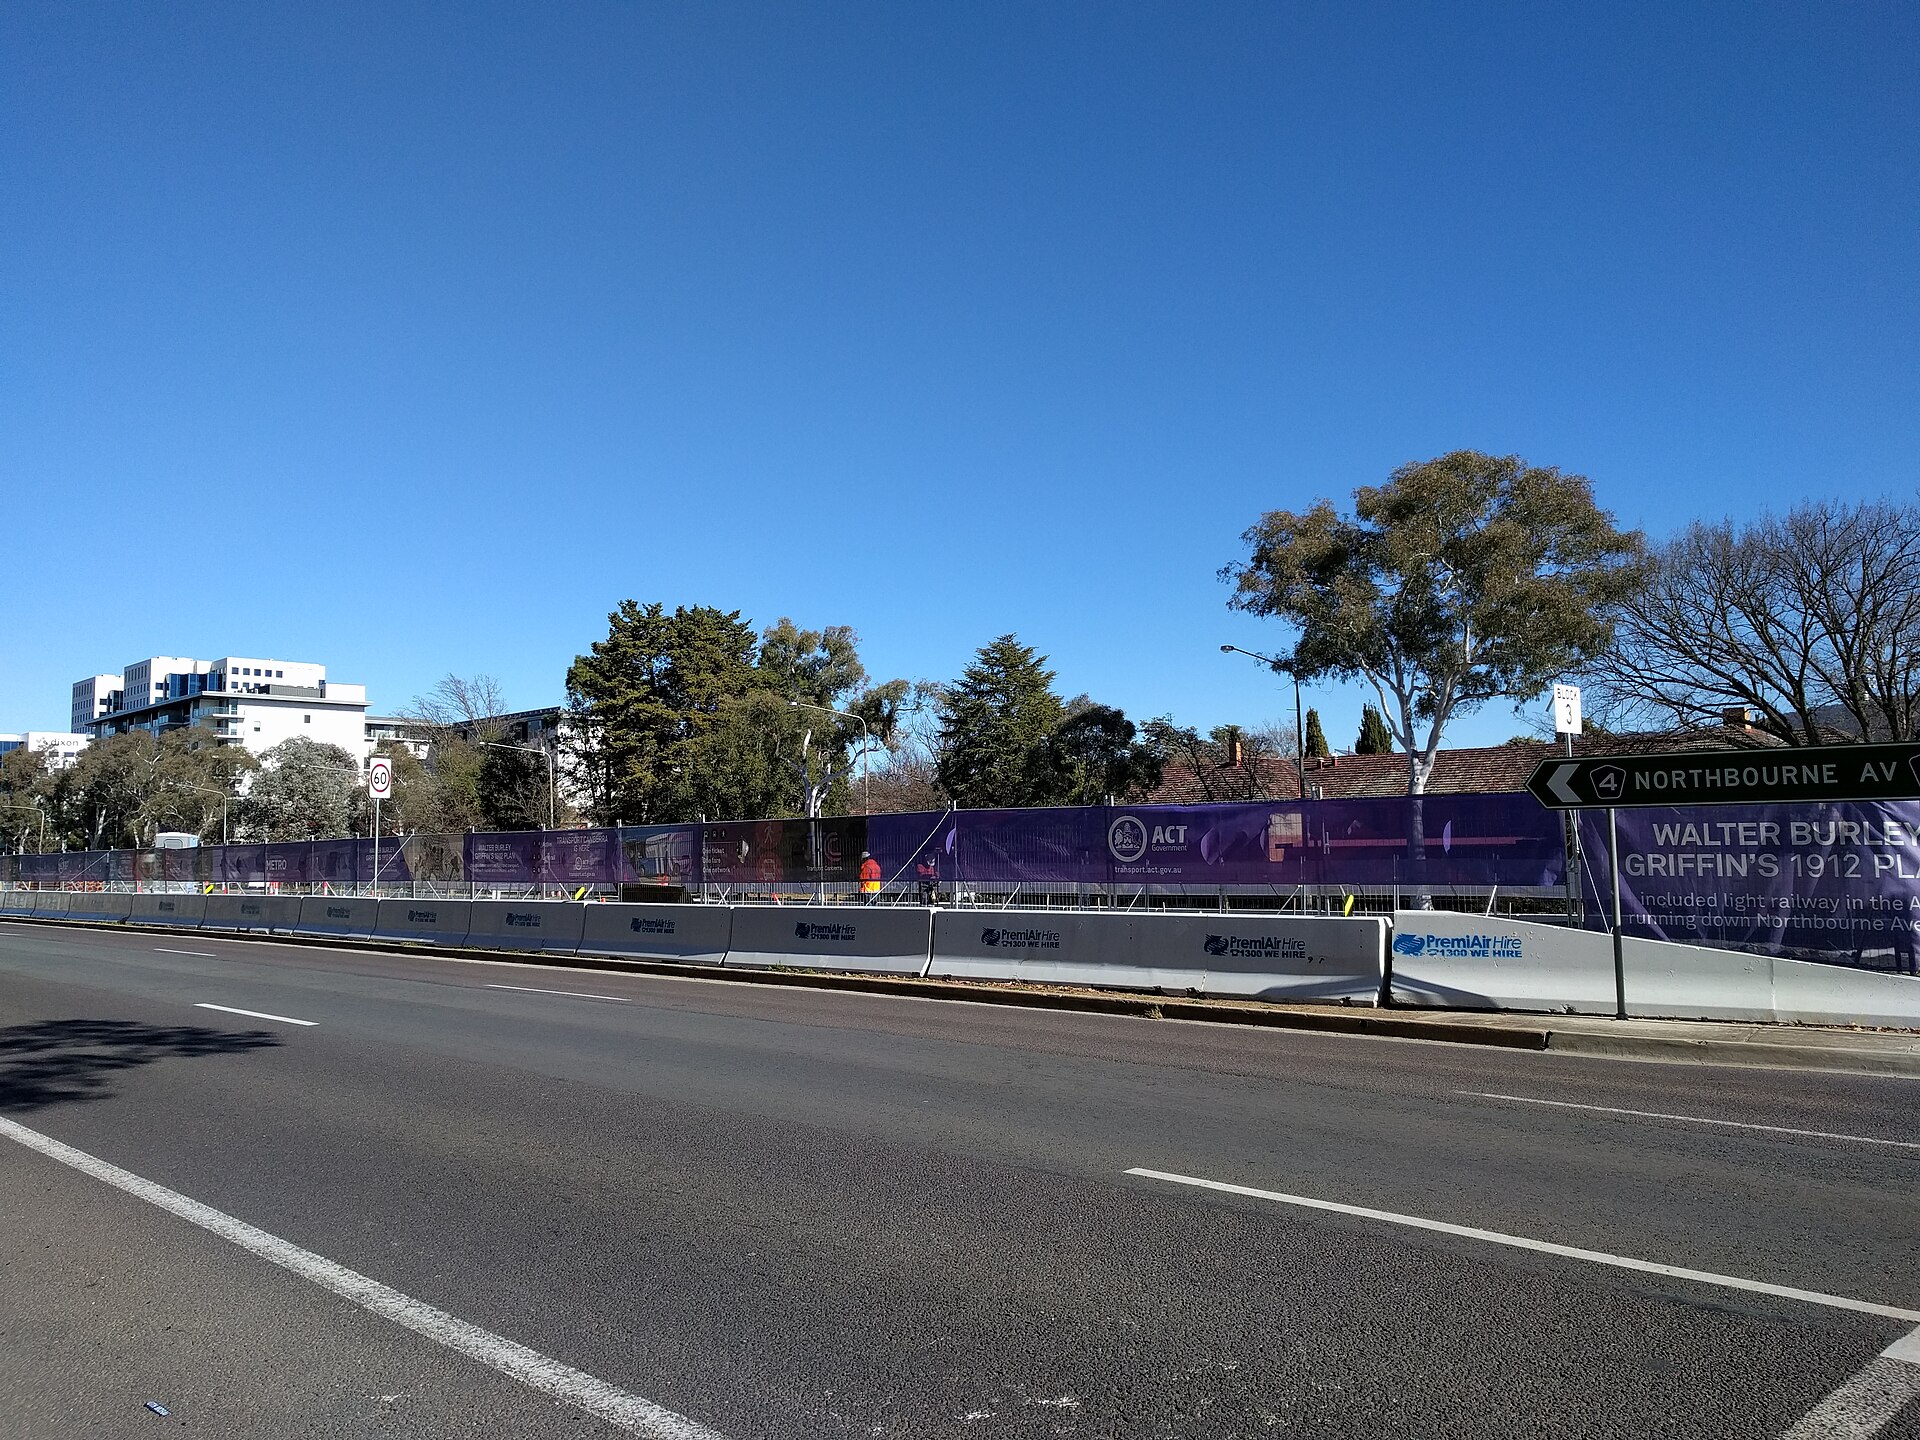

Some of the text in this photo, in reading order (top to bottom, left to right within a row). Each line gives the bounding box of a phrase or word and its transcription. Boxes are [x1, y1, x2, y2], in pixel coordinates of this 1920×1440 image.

[1557, 688, 1578, 700] BLOCK
[1566, 704, 1573, 725] 3
[374, 772, 386, 784] 60
[1599, 761, 1897, 791] 4 NORTHBOURNE AV
[1152, 826, 1188, 843] ACT
[1652, 821, 1920, 846] WALTER BURLEY
[266, 859, 287, 870] METRO
[1114, 866, 1182, 875] transport.act.gov.au
[1625, 853, 1920, 878] GRIFFIN'S 1912 PL
[1641, 892, 1718, 907] included
[1724, 893, 1766, 911] light
[1771, 894, 1840, 913] railway
[1846, 895, 1863, 910] in
[1869, 895, 1903, 910] the
[1629, 911, 1697, 930] running
[1701, 912, 1750, 927] down
[1757, 913, 1884, 931] Northbourne
[1440, 949, 1467, 957] 1300
[1470, 949, 1489, 957] WE
